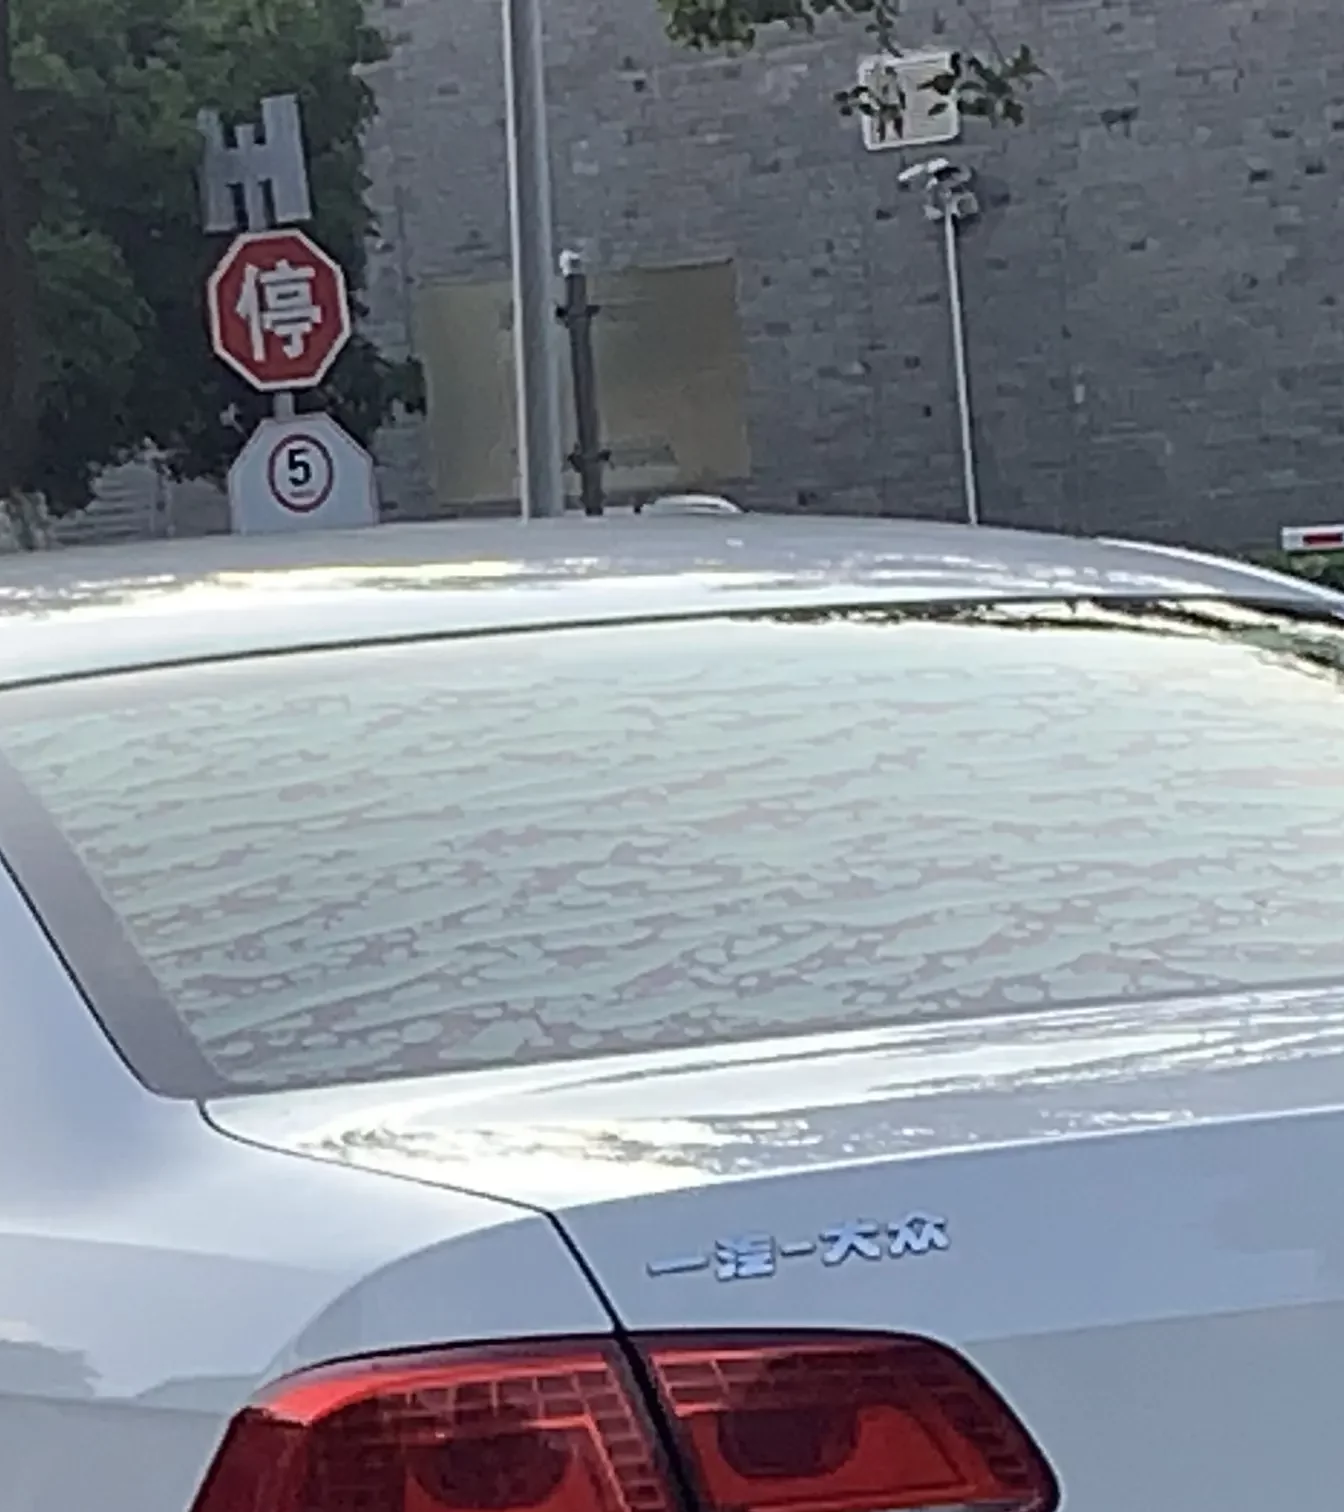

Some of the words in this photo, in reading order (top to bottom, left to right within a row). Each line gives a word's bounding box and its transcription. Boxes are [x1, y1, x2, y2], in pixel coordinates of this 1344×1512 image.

[235, 259, 322, 362] 停
[286, 447, 313, 488] 5
[646, 1210, 950, 1282] 一汽-大众
